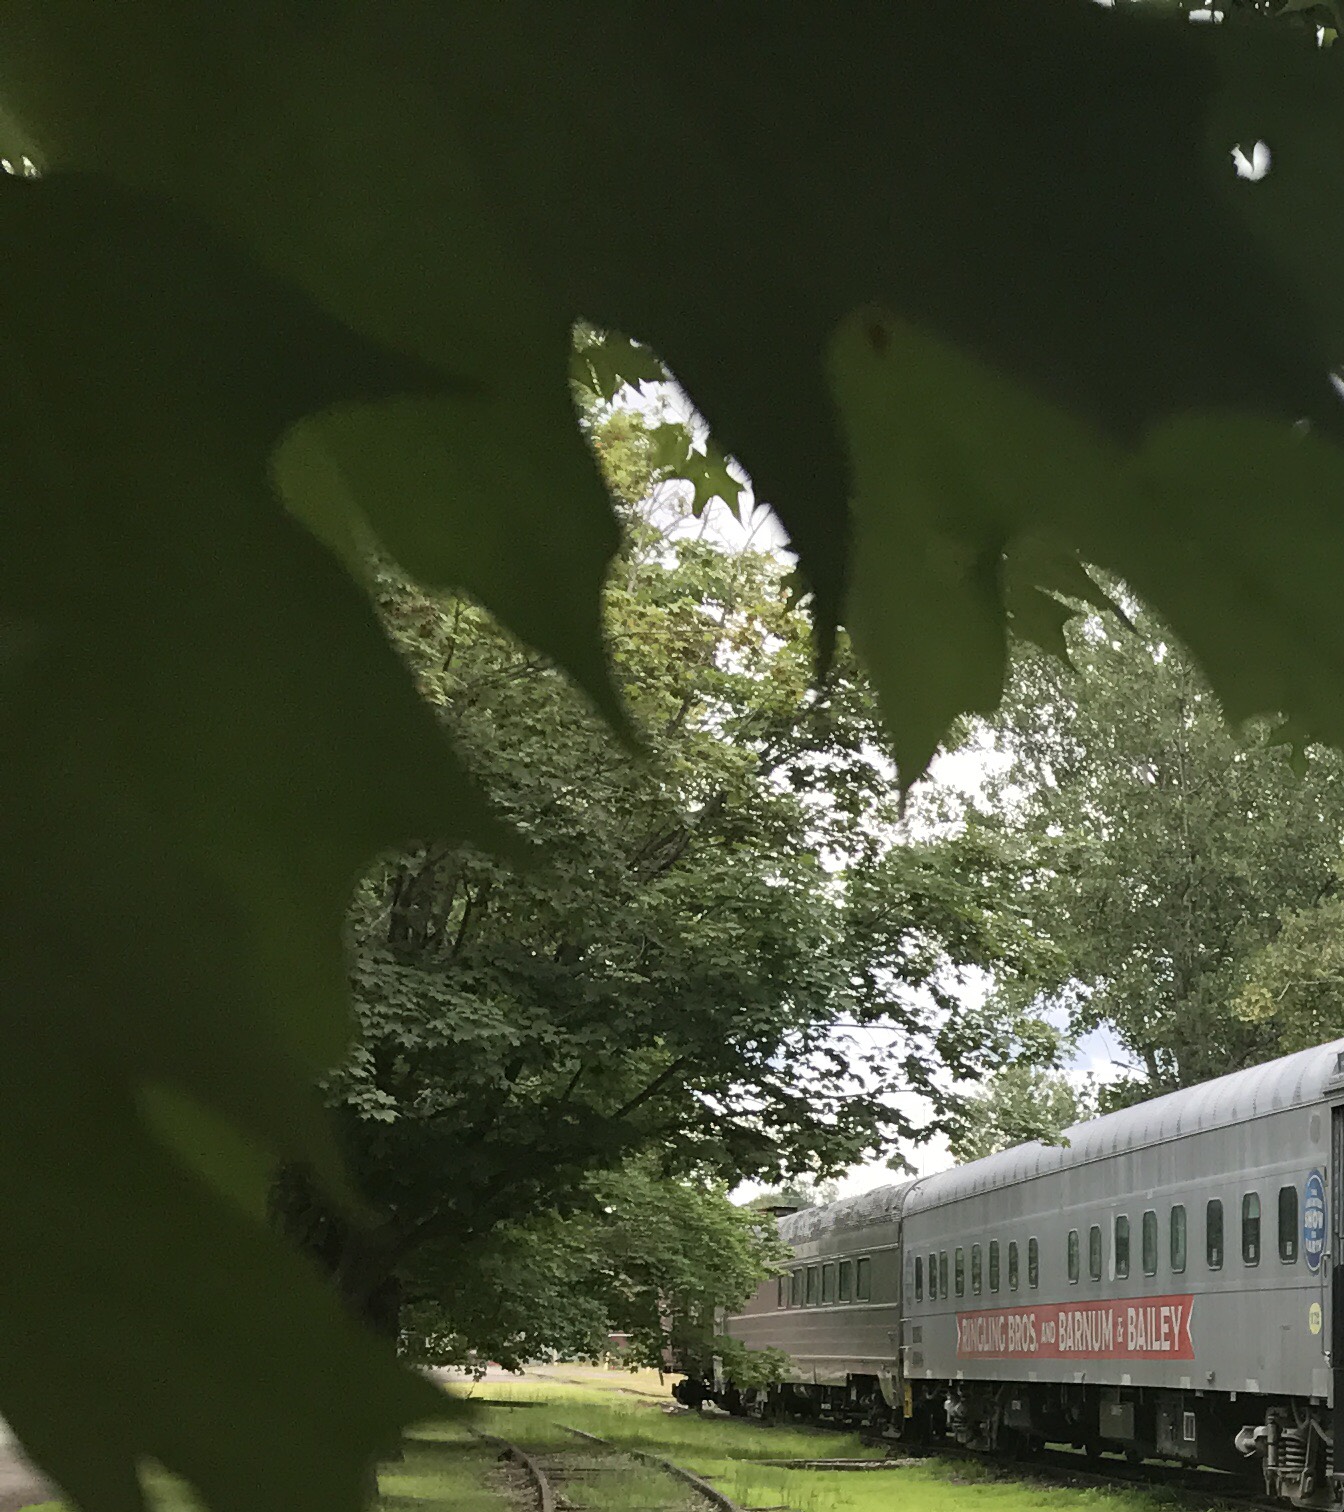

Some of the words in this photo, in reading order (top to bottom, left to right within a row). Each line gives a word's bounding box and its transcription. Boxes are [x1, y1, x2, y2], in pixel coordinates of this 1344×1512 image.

[961, 1316, 1005, 1353] RINGLING
[1008, 1313, 1039, 1352] BROS.
[1041, 1320, 1056, 1344] AND
[1058, 1309, 1114, 1352] BARNUM
[1117, 1317, 1124, 1343] &
[1127, 1306, 1183, 1351] BAILEY
